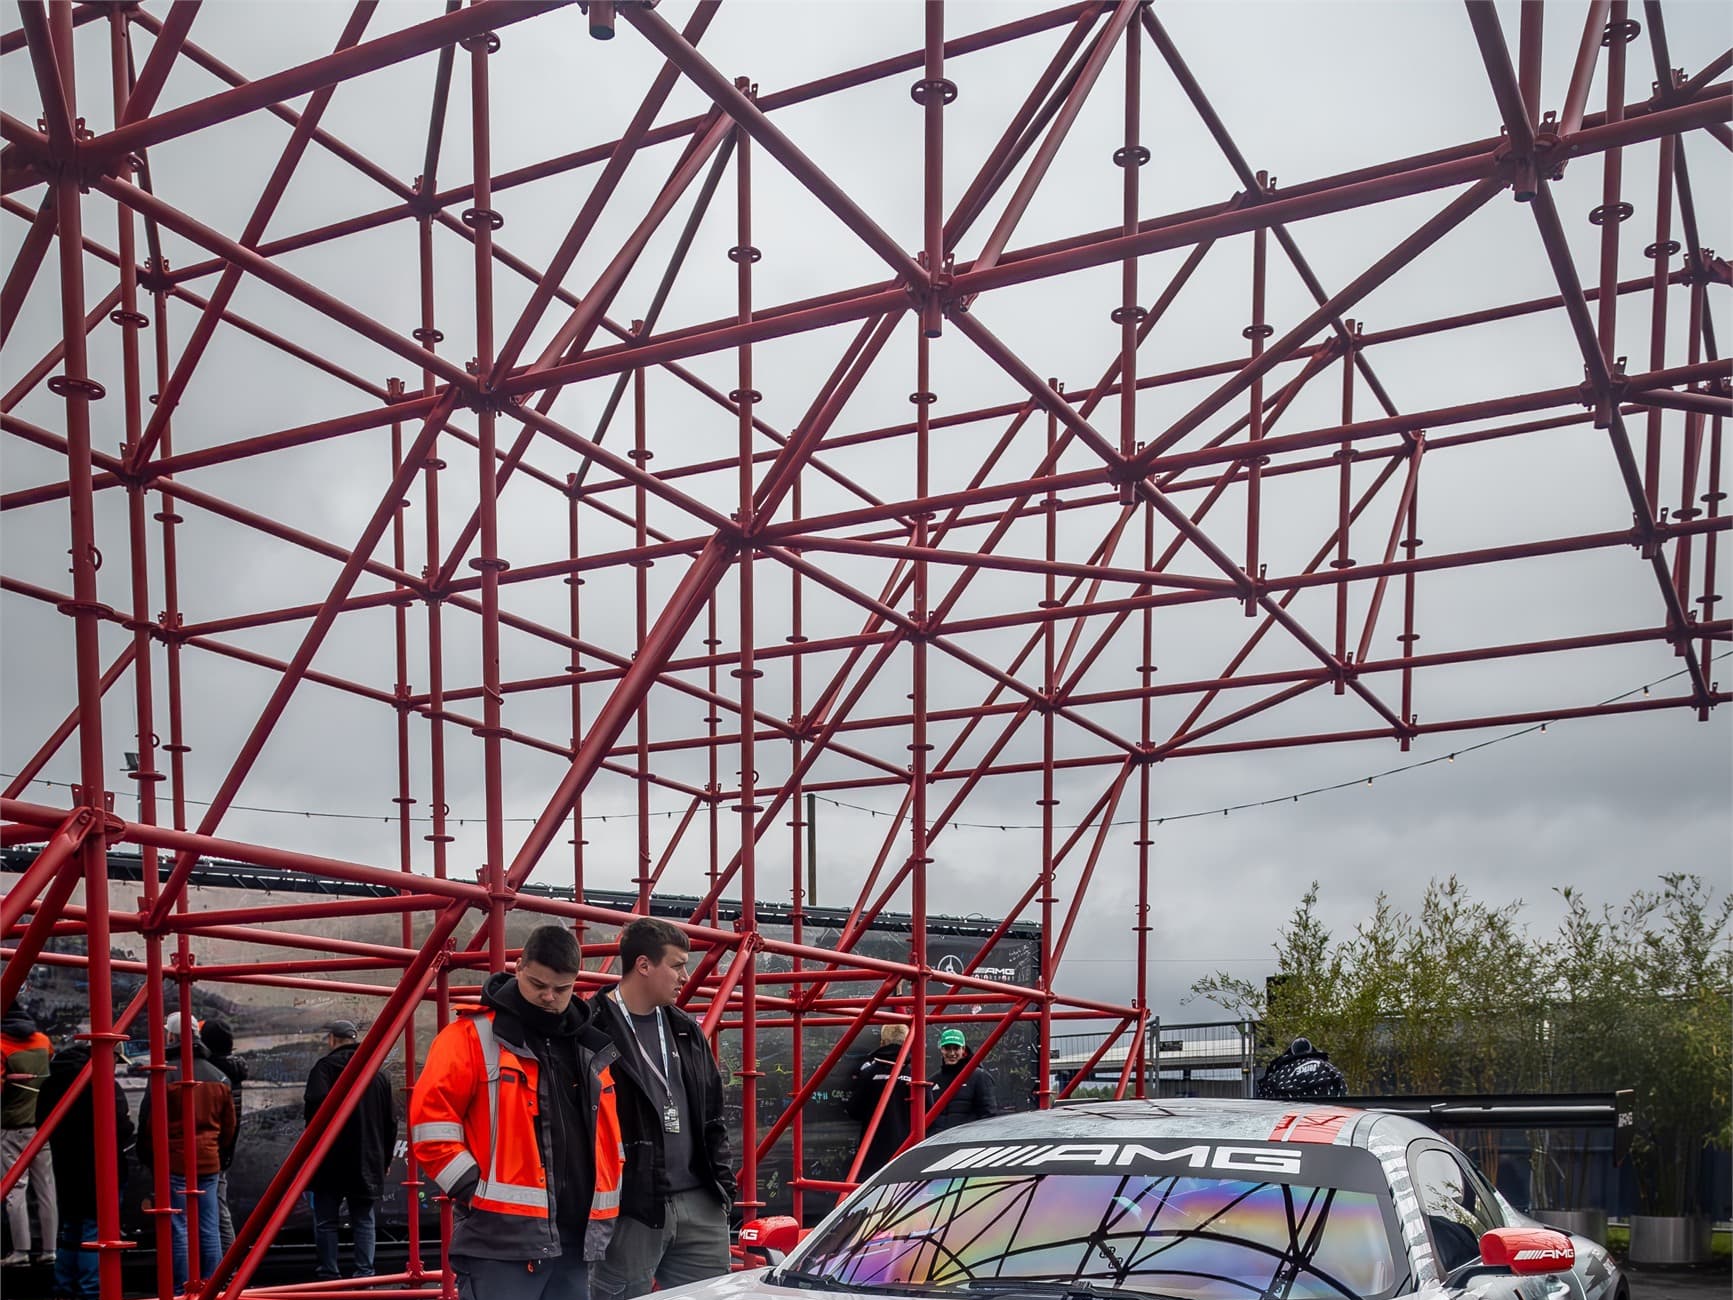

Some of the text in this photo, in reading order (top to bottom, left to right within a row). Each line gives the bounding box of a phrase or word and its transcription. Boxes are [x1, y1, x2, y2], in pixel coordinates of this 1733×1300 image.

[1023, 1143, 1302, 1175] AMG
[739, 1228, 759, 1241] MG
[1539, 1248, 1574, 1259] AMG
